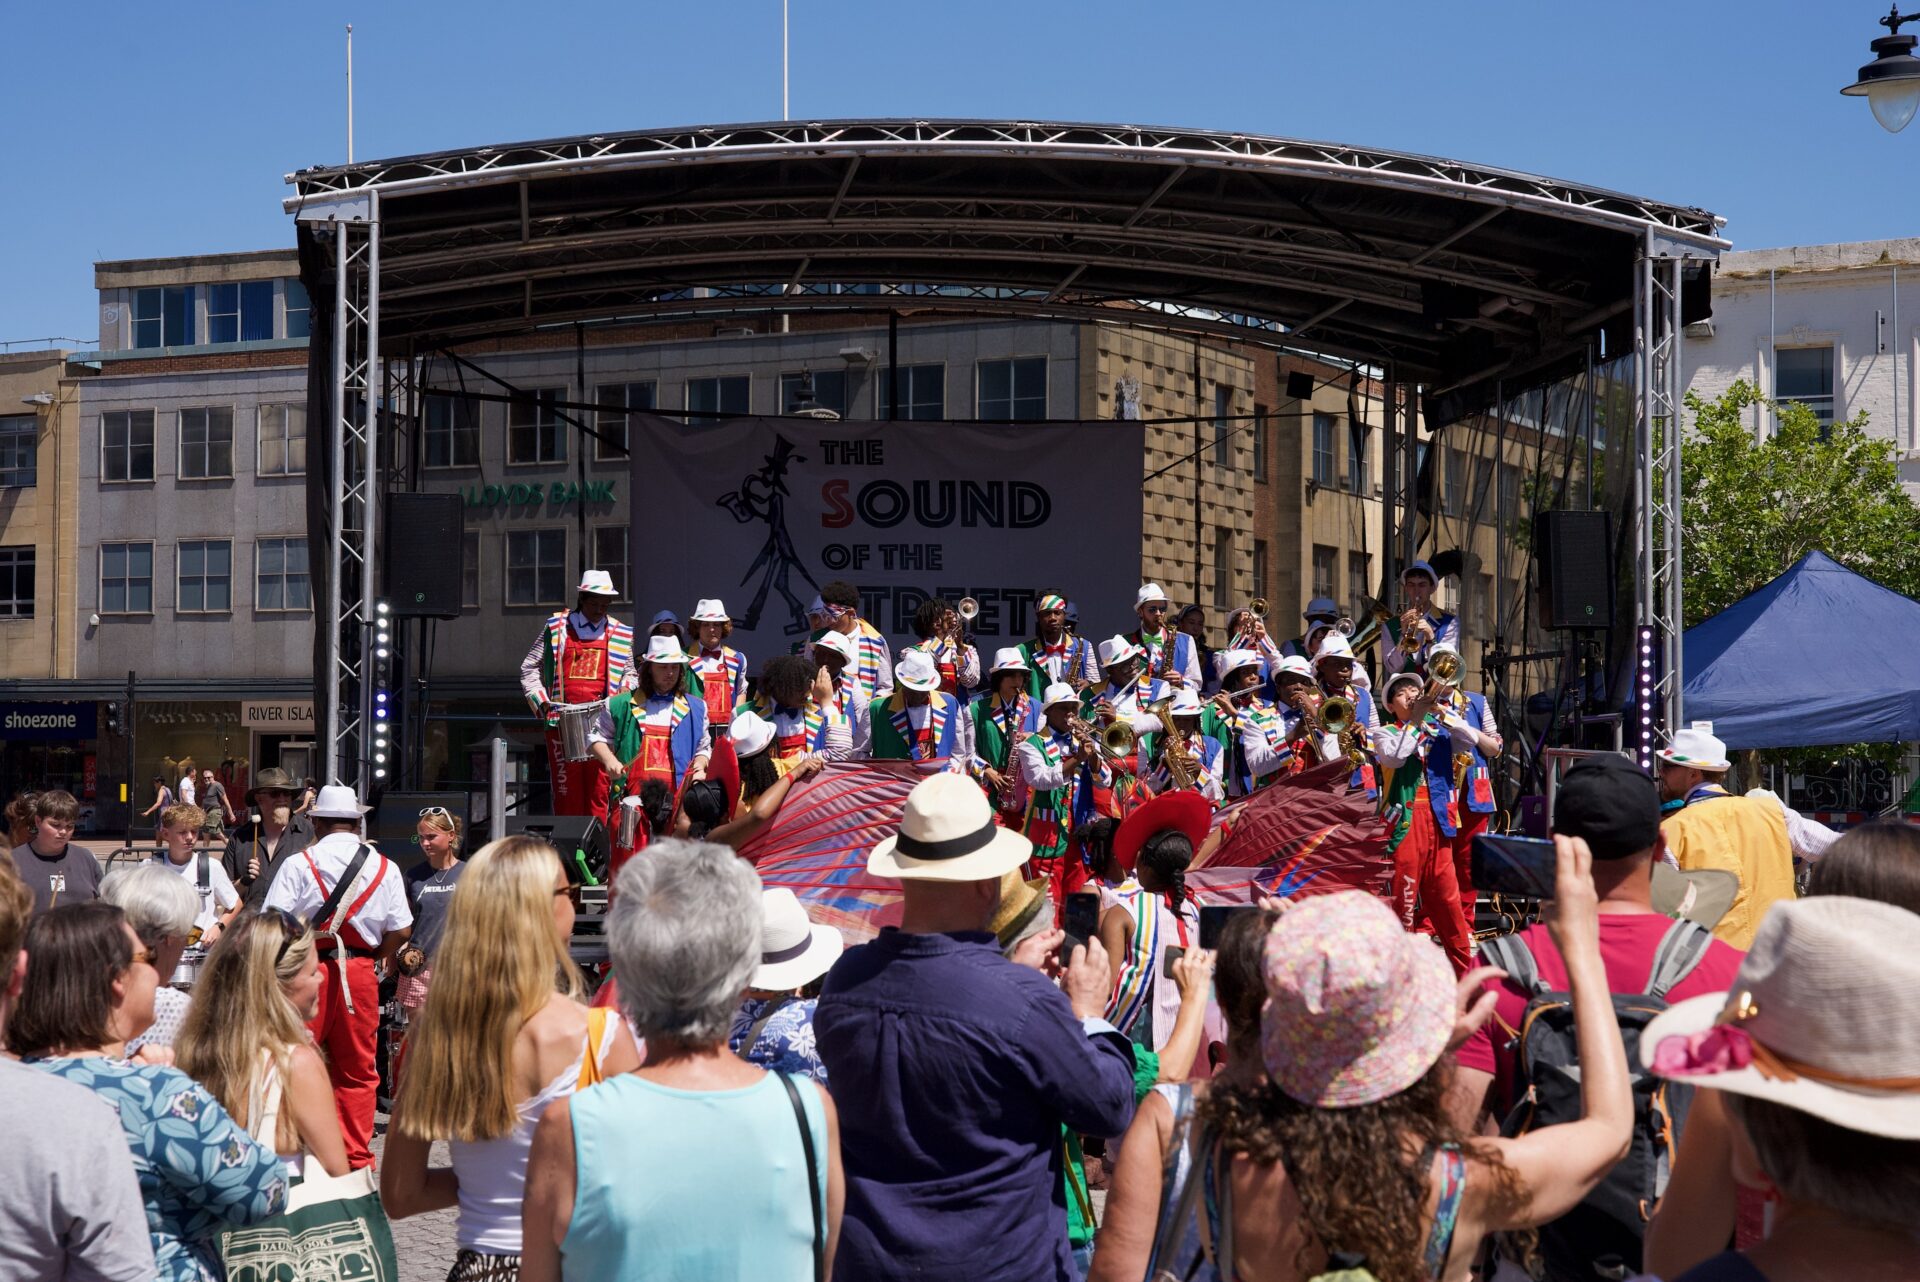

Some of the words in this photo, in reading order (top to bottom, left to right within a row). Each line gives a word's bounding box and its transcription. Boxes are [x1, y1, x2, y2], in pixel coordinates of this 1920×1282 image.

[819, 439, 884, 466] THE
[551, 480, 617, 504] BANK
[821, 478, 1052, 529] SOUND
[821, 543, 870, 571] OF
[878, 543, 944, 571] THE
[856, 586, 1036, 637] TRET
[5, 711, 77, 728] shoezone
[249, 706, 283, 721] RIVER
[287, 706, 314, 721] ISLA
[1402, 875, 1416, 931] UNITY
